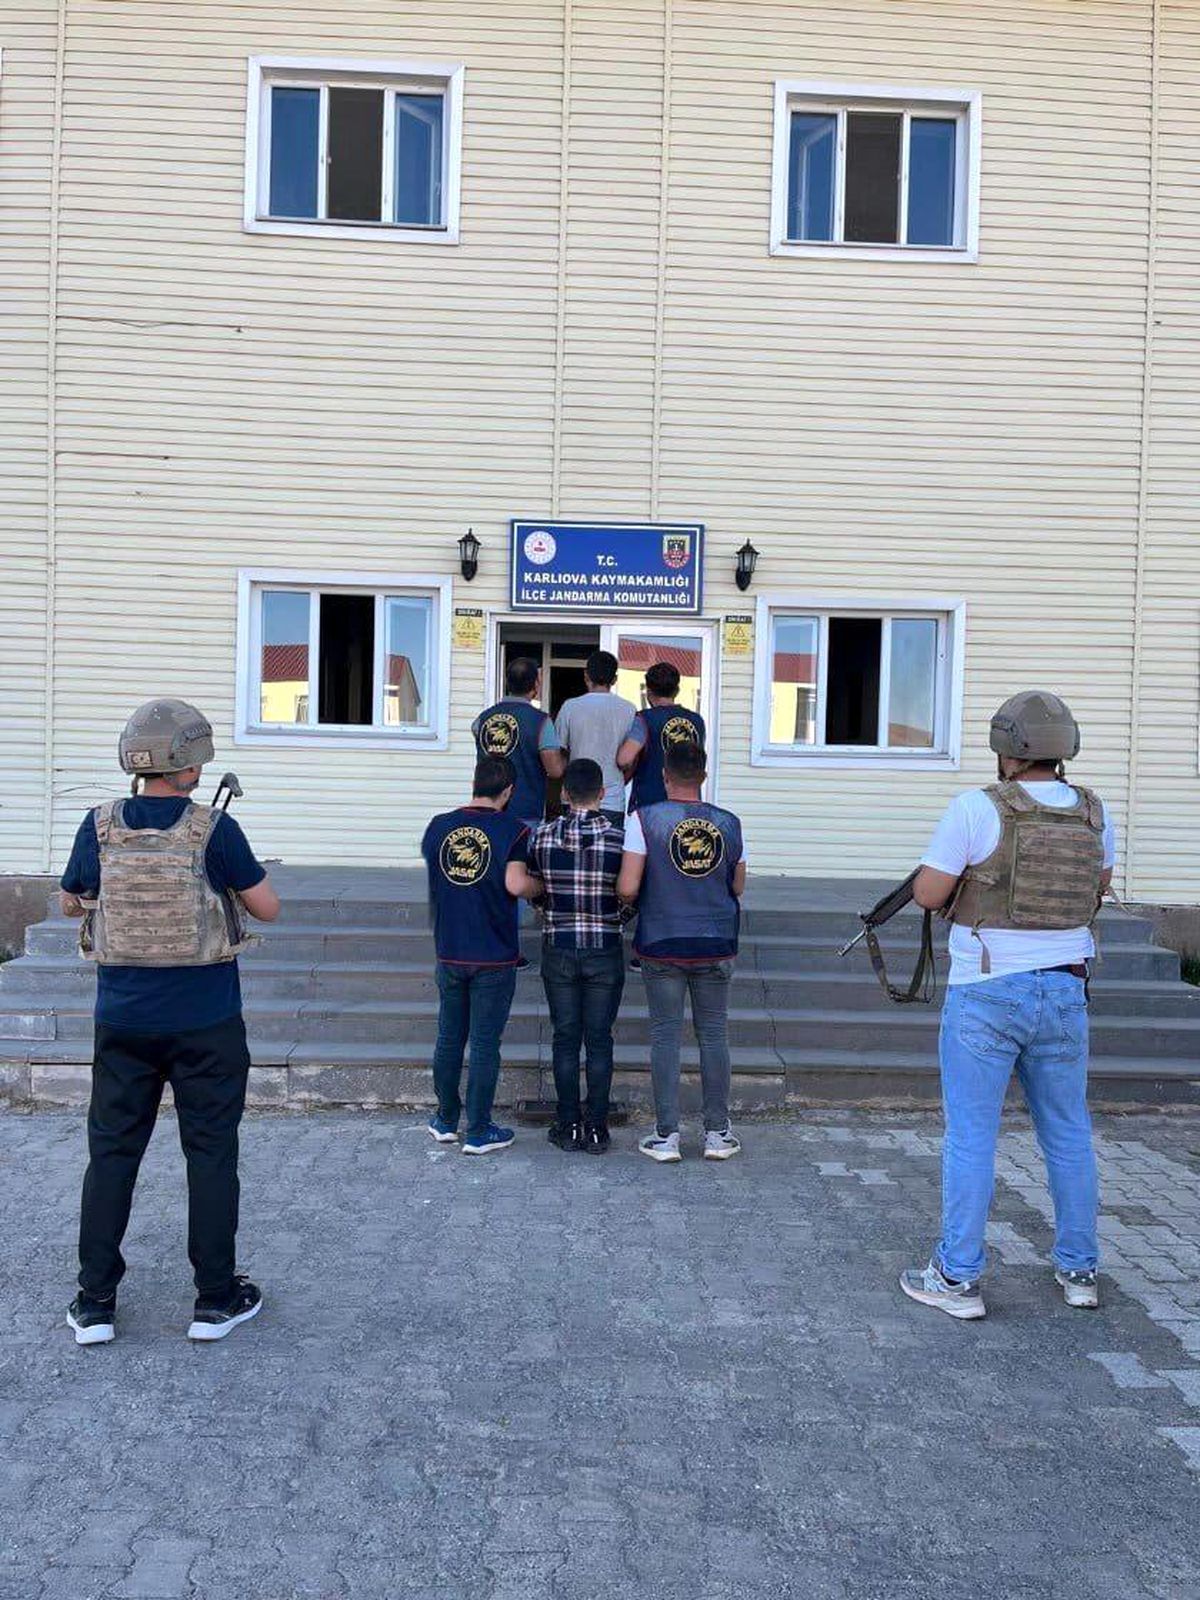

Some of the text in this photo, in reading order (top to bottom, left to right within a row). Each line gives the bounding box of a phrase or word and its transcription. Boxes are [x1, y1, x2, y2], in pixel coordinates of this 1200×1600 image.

[597, 555, 618, 567] T.C.
[524, 572, 689, 587] KARLIOVA KAYMAKAMLIĞI
[549, 591, 610, 602] JANDARMA
[613, 592, 690, 605] KOMUTANLIĞI
